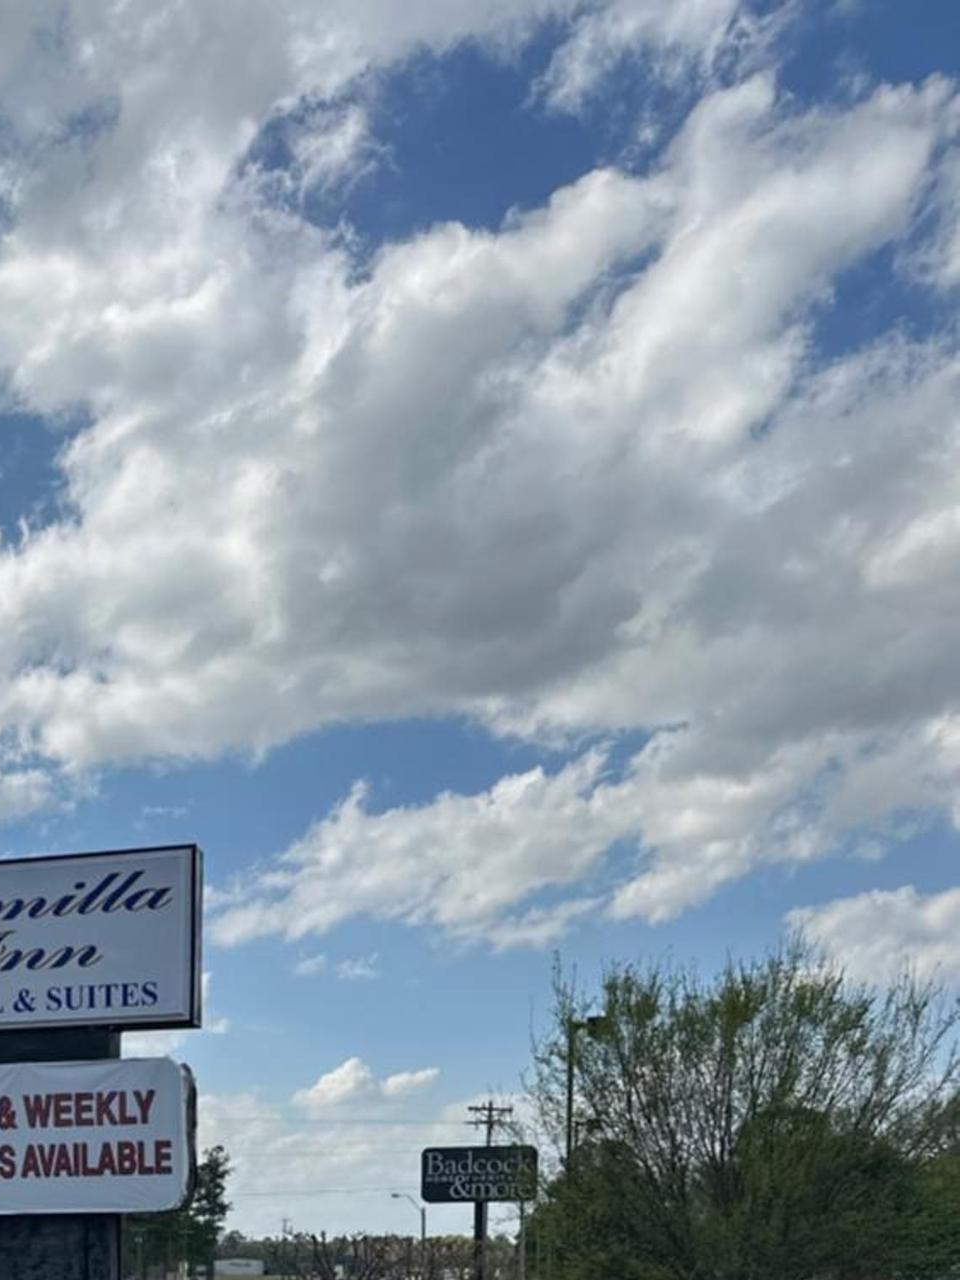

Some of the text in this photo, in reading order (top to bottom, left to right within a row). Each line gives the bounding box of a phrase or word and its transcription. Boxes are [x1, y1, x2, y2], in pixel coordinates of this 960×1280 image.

[13, 987, 37, 1013] &
[45, 981, 159, 1011] SUITES
[23, 1089, 156, 1129] WEEKLY
[21, 1140, 172, 1179] AVAILABLE
